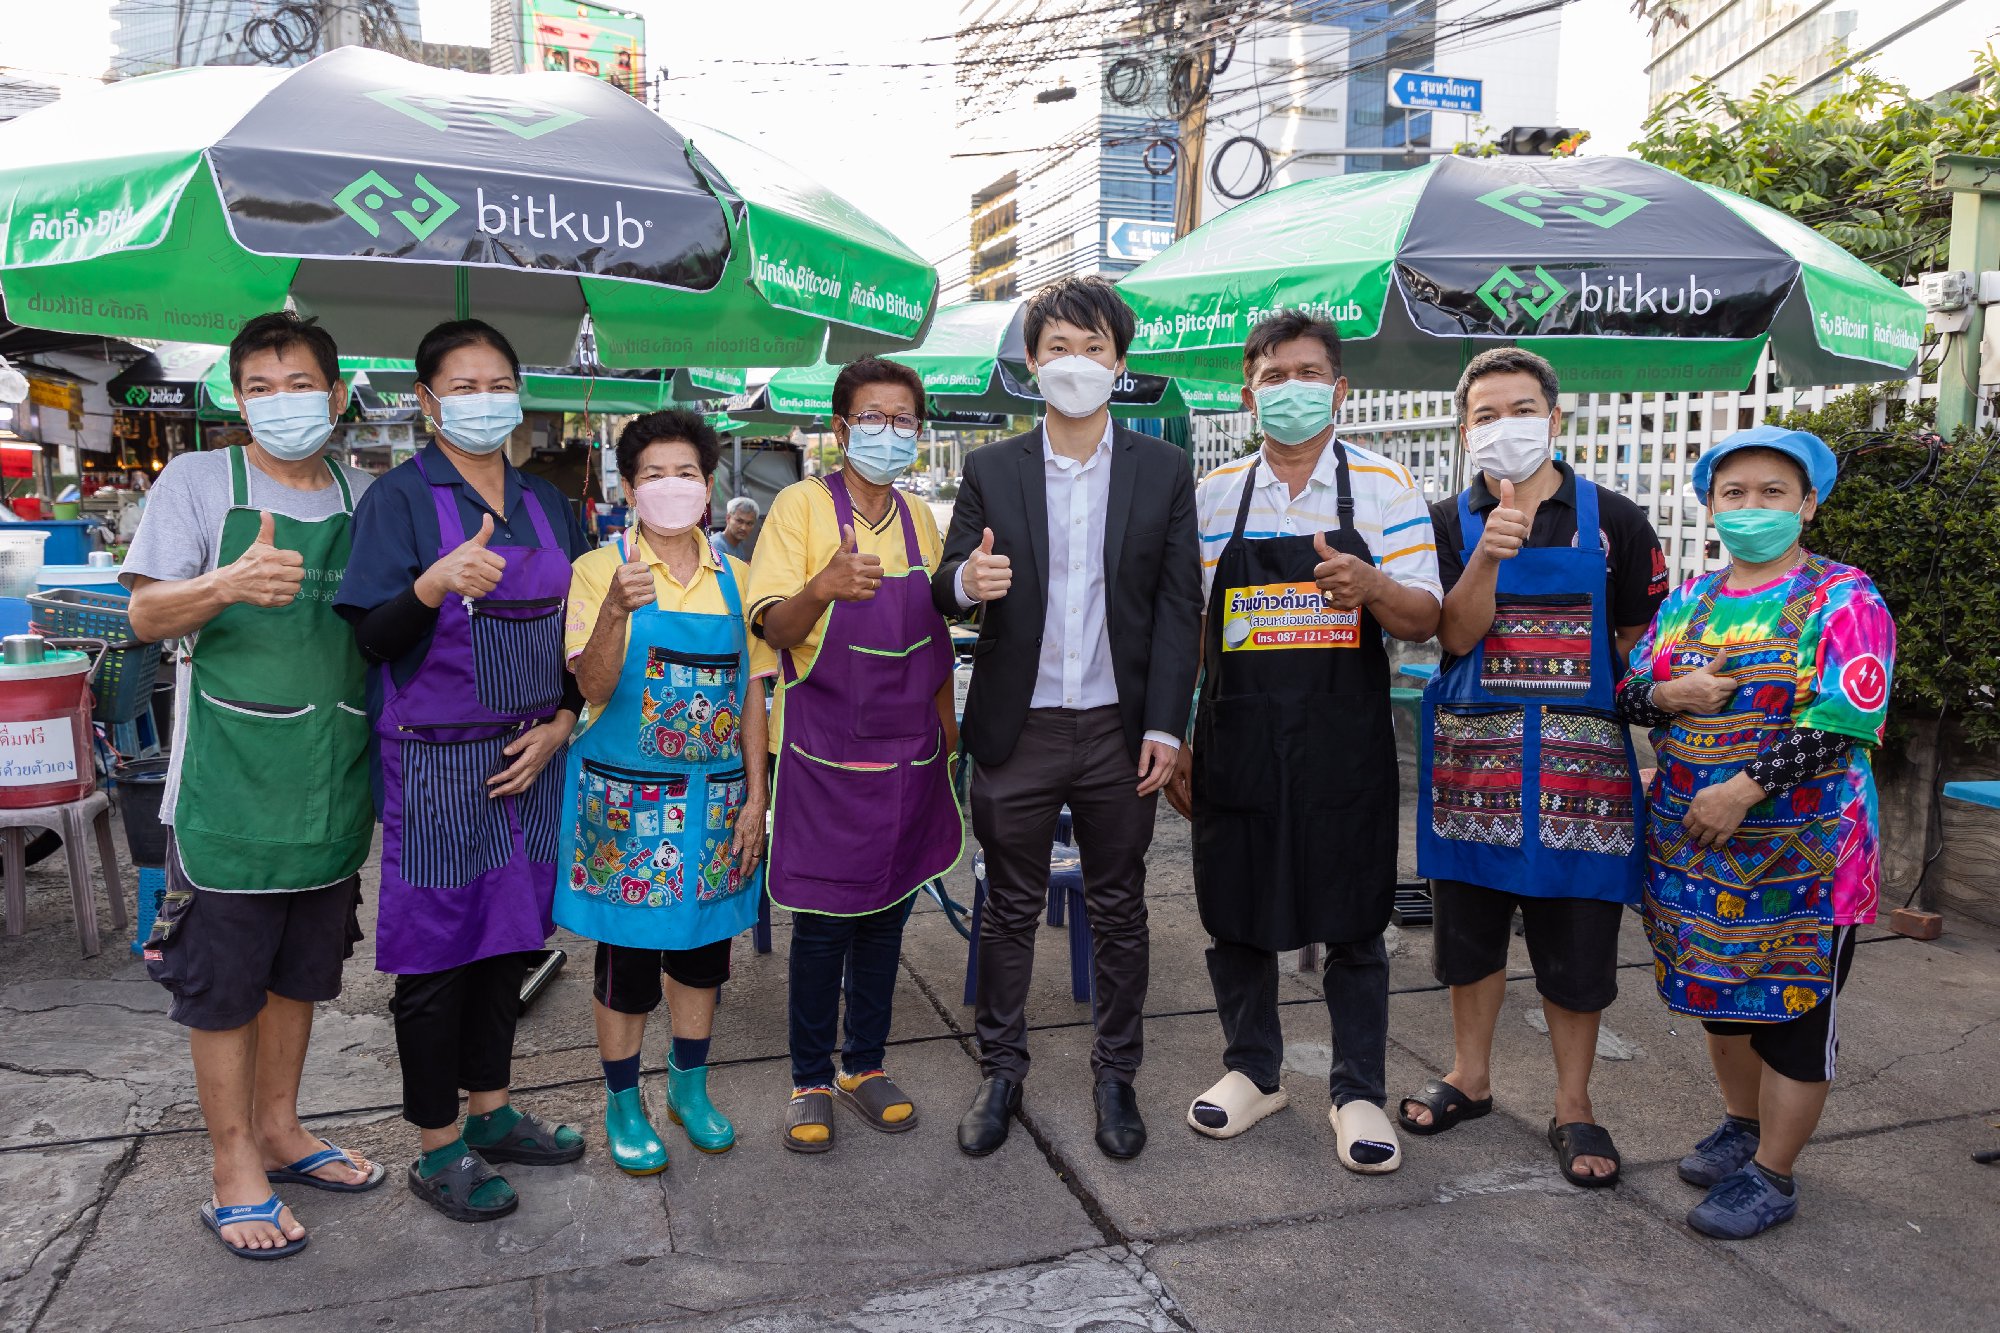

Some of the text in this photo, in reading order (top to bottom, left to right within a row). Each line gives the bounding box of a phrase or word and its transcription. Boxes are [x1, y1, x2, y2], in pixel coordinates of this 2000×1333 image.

[29, 208, 93, 240] คิดถึง
[796, 265, 842, 299] Bitcoin
[886, 291, 924, 322] Bitkub
[1175, 313, 1233, 334] Bitcoin
[1277, 630, 1354, 642] 087-121-3644
